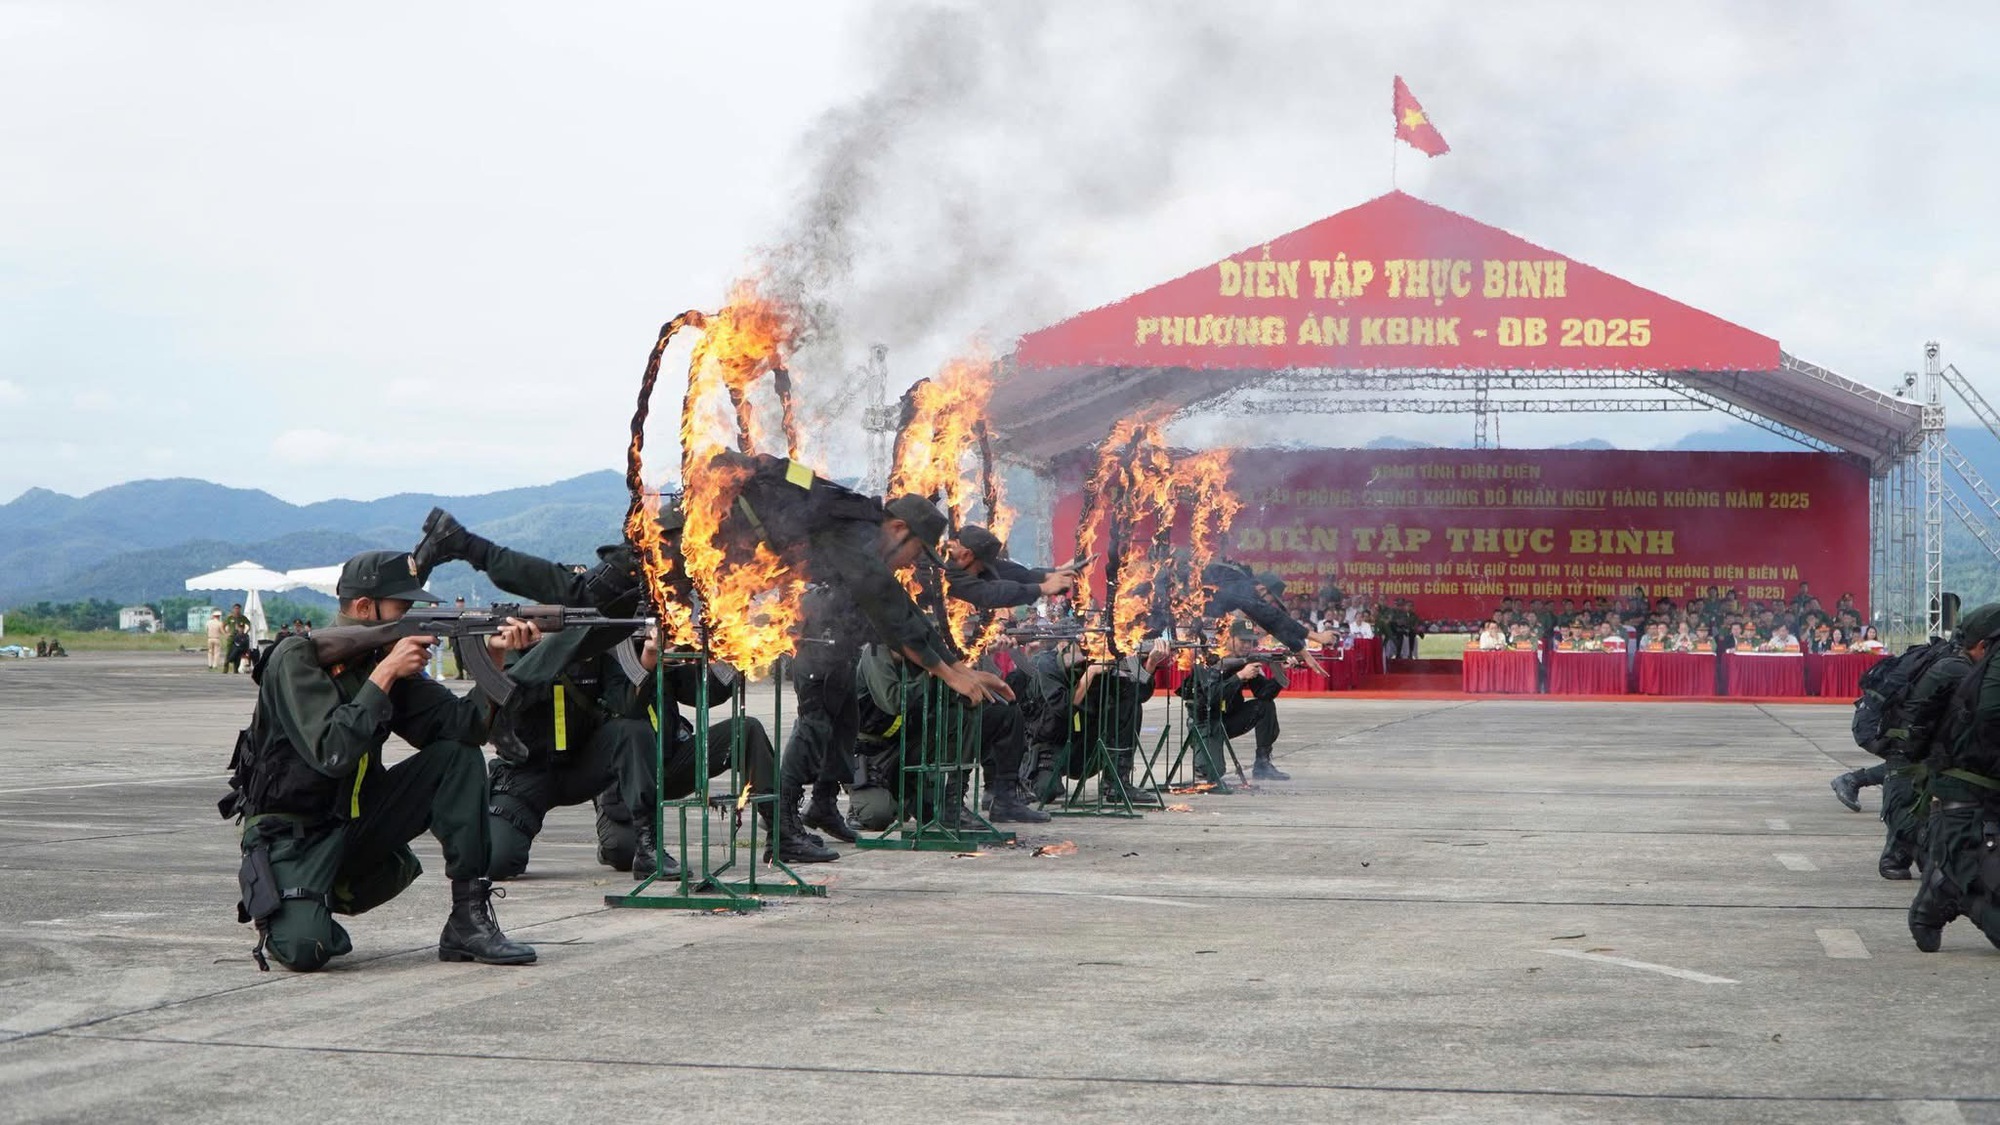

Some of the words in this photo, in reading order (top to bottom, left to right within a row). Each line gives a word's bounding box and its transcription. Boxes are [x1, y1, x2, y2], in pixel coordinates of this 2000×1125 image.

[1309, 251, 1374, 306] TẬP
[1384, 258, 1472, 306] THỰC
[1483, 259, 1567, 299] BINH
[1136, 313, 1288, 346] PHƯƠNG
[1298, 311, 1349, 346] ÁN
[1360, 316, 1461, 346] KBHK
[1498, 317, 1547, 347] ĐB
[1560, 318, 1651, 347] 2025
[1563, 489, 1606, 507] NGUY
[1612, 487, 1658, 508] HÀNG
[1663, 487, 1720, 509] KHÔNG
[1725, 488, 1764, 509] NĂM
[1769, 491, 1810, 510] 2025
[1352, 523, 1431, 558] TẬP
[1446, 527, 1555, 558] THỰC
[1569, 528, 1675, 555] BINH
[1509, 563, 1536, 577] CON
[1540, 564, 1560, 577] TIN
[1564, 564, 1583, 580] TẠI
[1588, 560, 1623, 578] CẢNG
[1627, 562, 1662, 579] HÀNG
[1666, 562, 1710, 580] KHÔNG
[1713, 562, 1744, 581] ĐIỆN
[1748, 562, 1778, 580] BIÊN
[1508, 583, 1529, 597] TIN
